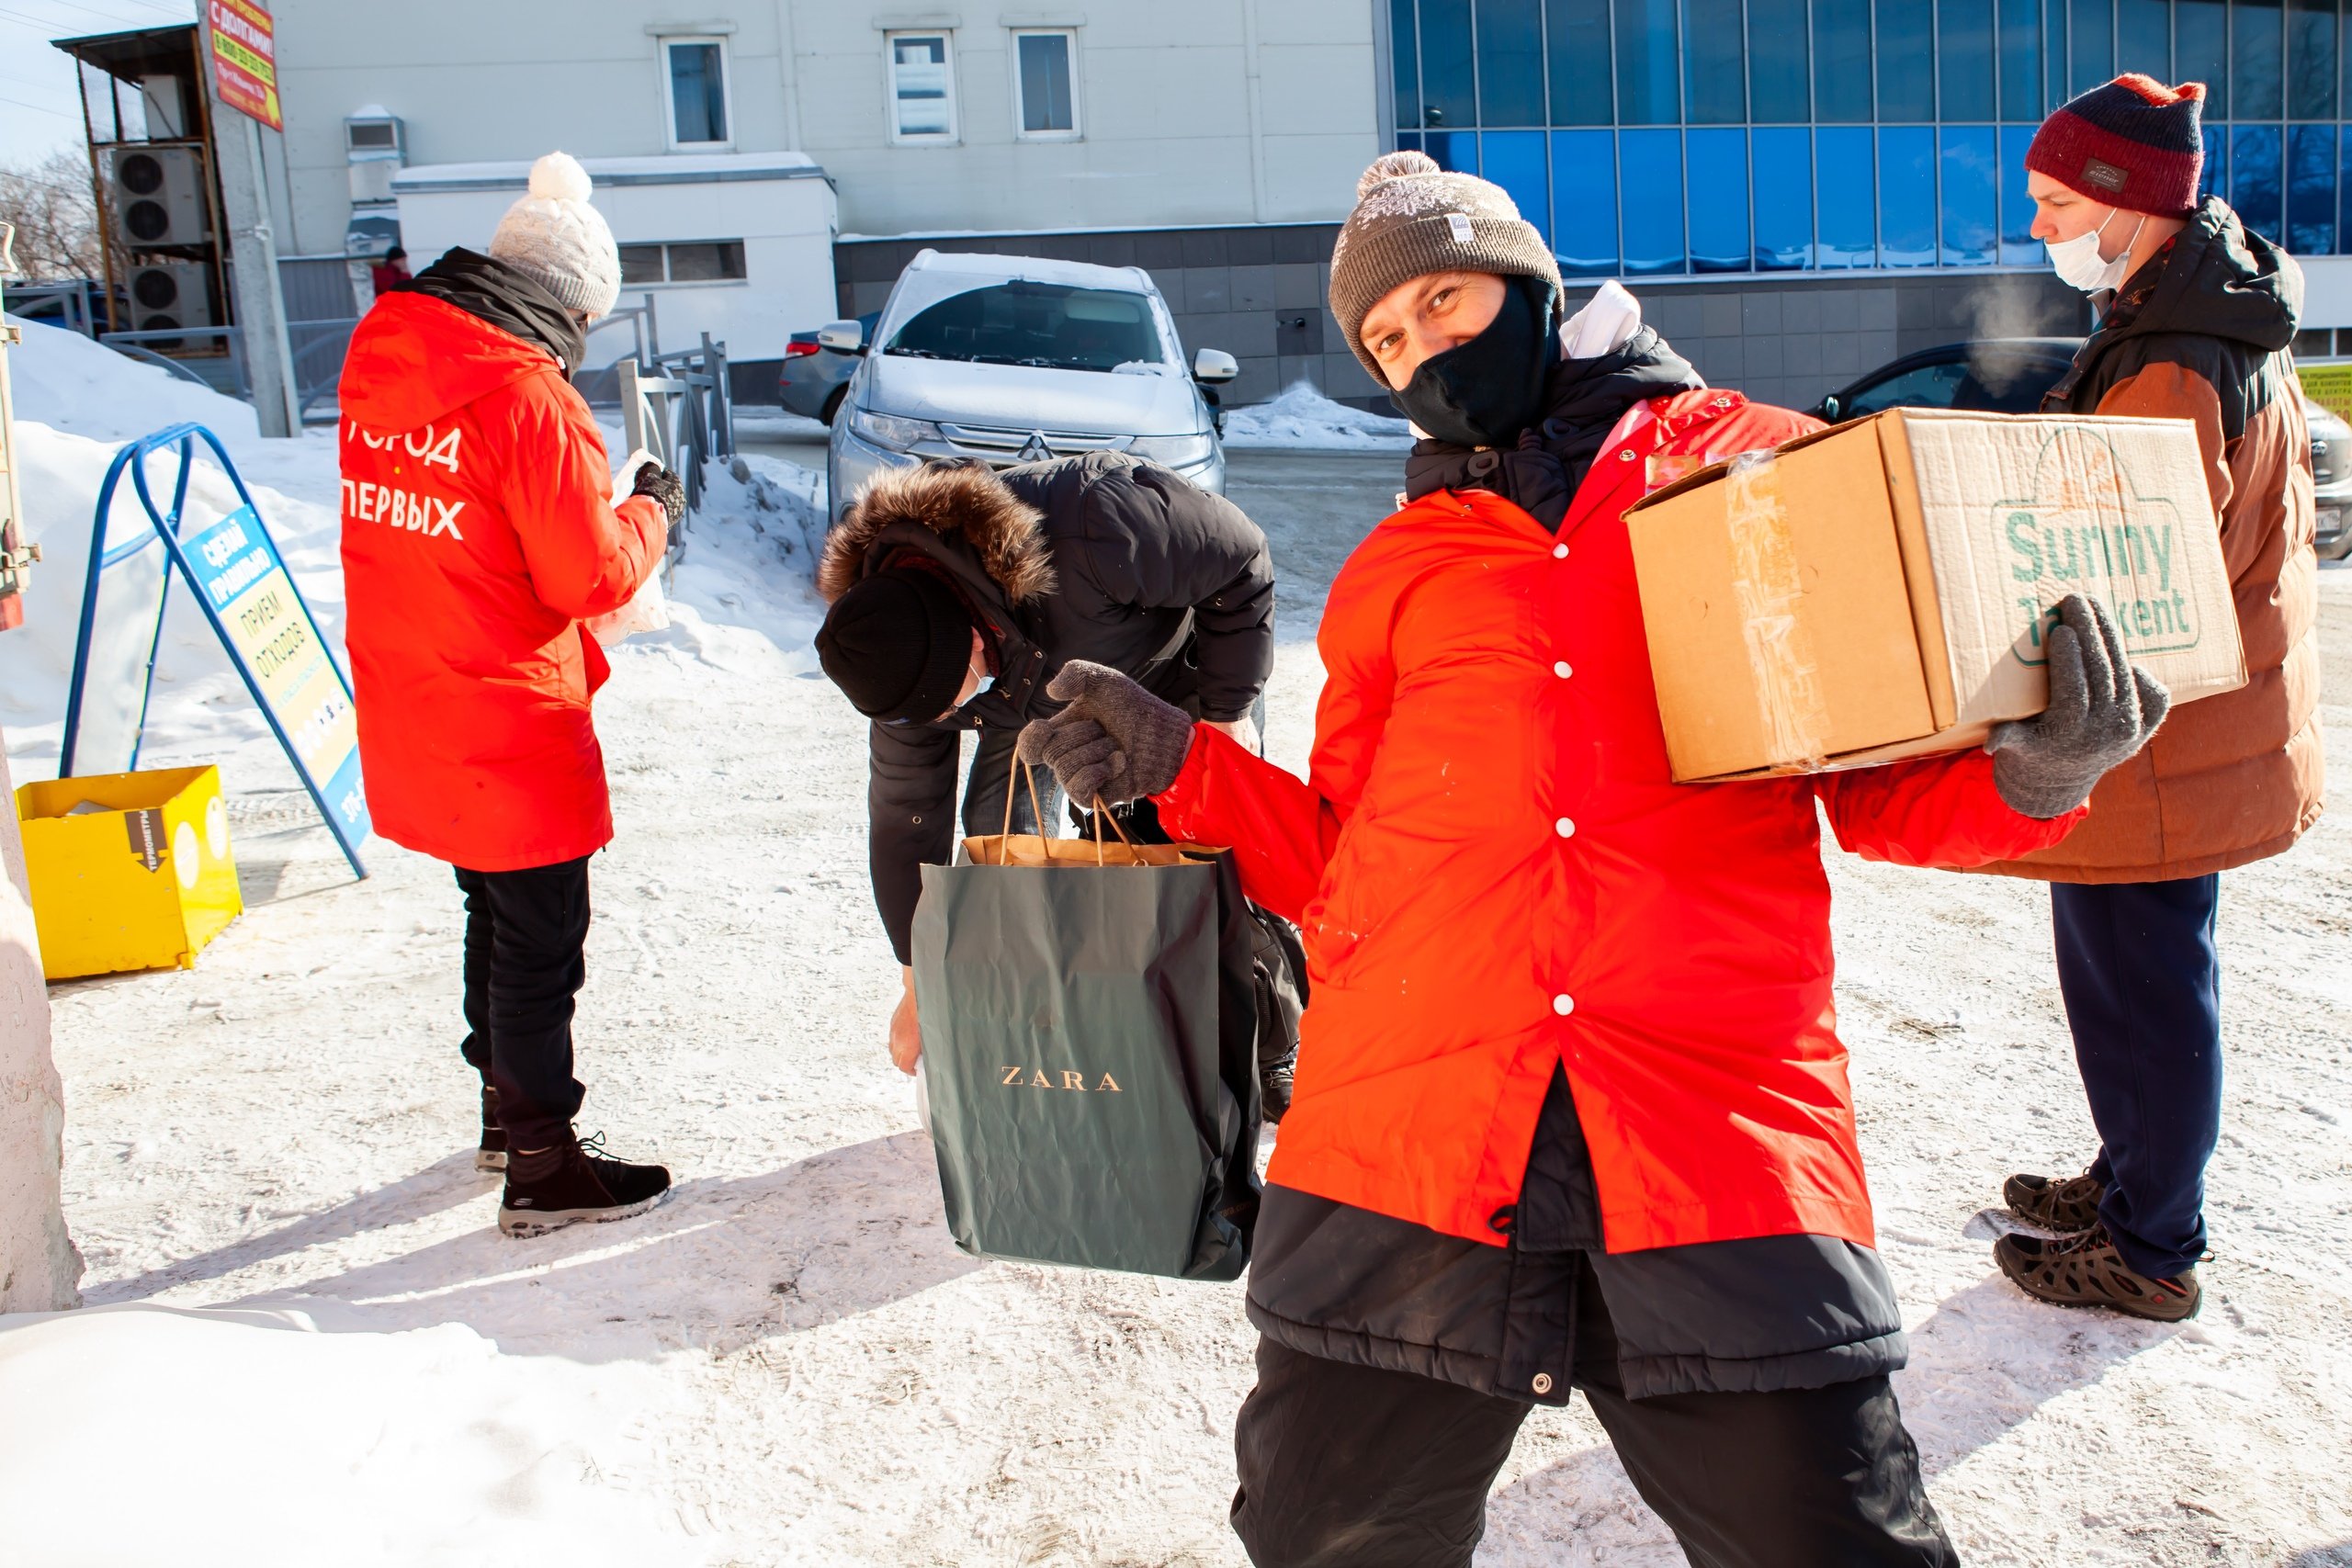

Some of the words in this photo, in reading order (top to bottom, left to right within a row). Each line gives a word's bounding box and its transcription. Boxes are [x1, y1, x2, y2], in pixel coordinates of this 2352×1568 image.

[210, 1, 220, 23] С
[220, 6, 274, 58] ДОЛГАМИ!
[340, 478, 466, 541] ПЕРВЫХ
[202, 518, 249, 569] СДЕЛАЙ
[2006, 512, 2171, 592] Sunny
[208, 547, 272, 605] ПРАВИЛЬНО
[240, 590, 284, 638] ПРИЕМ
[2018, 589, 2190, 647] Takent
[254, 621, 306, 678] ОТХОДОВ
[139, 809, 157, 871] ТЕРМОМЕТРЫ
[1001, 1066, 1123, 1091] ZARA
